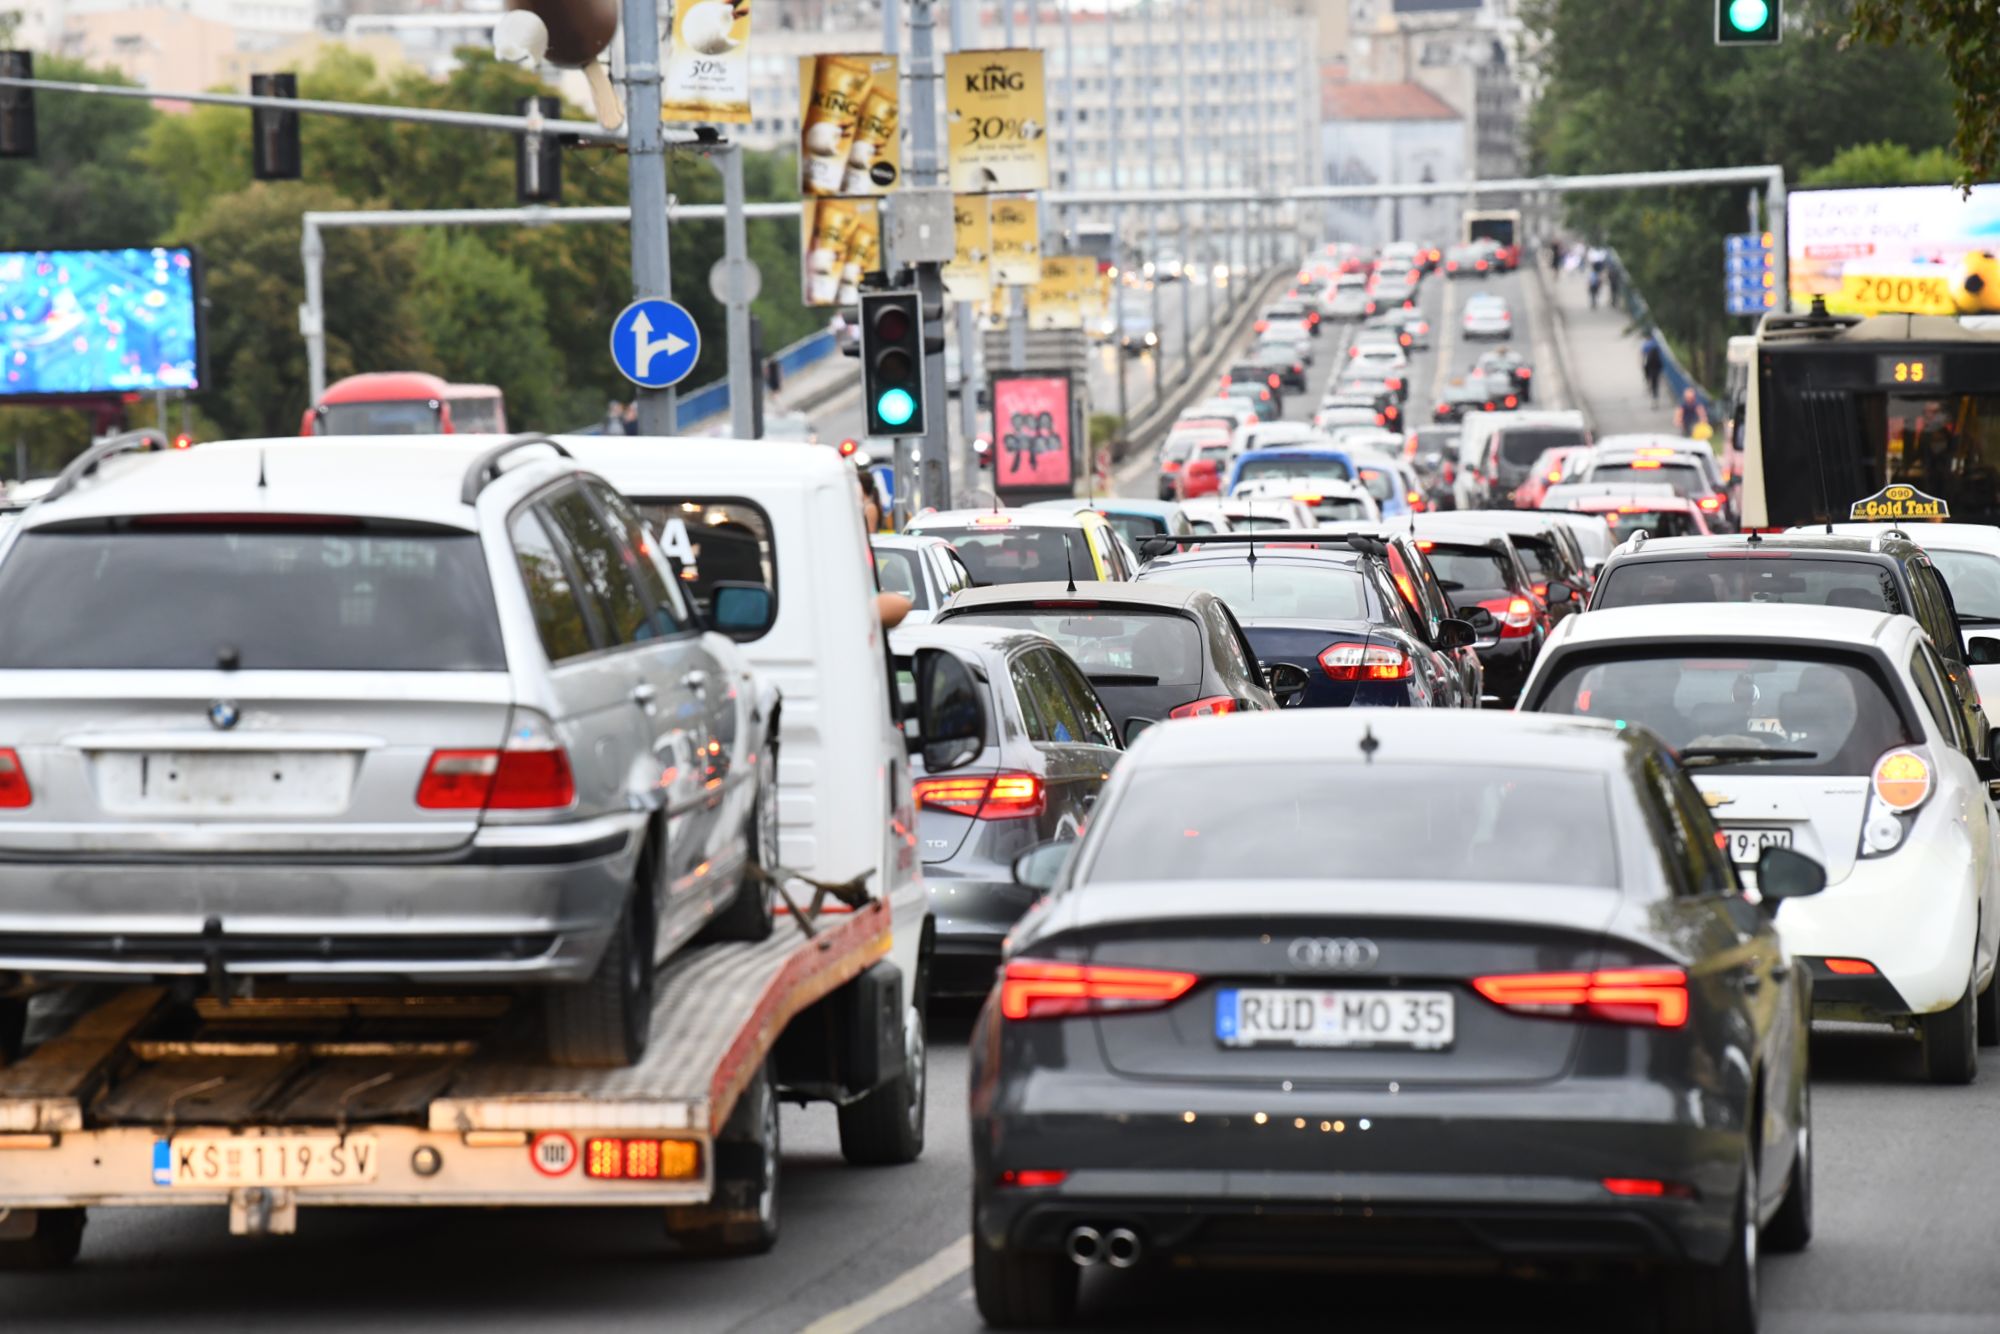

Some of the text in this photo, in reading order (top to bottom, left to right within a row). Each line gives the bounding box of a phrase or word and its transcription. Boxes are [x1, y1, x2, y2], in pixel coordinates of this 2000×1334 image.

[966, 73, 1024, 92] KING
[1856, 277, 1942, 305] 200%
[1894, 362, 1924, 382] 35
[1890, 489, 1910, 498] 090
[1866, 500, 1903, 516] Gold
[1906, 498, 1939, 515] Taxi
[926, 839, 948, 848] TDI
[1402, 1001, 1446, 1034] 35
[543, 1145, 565, 1163] 100
